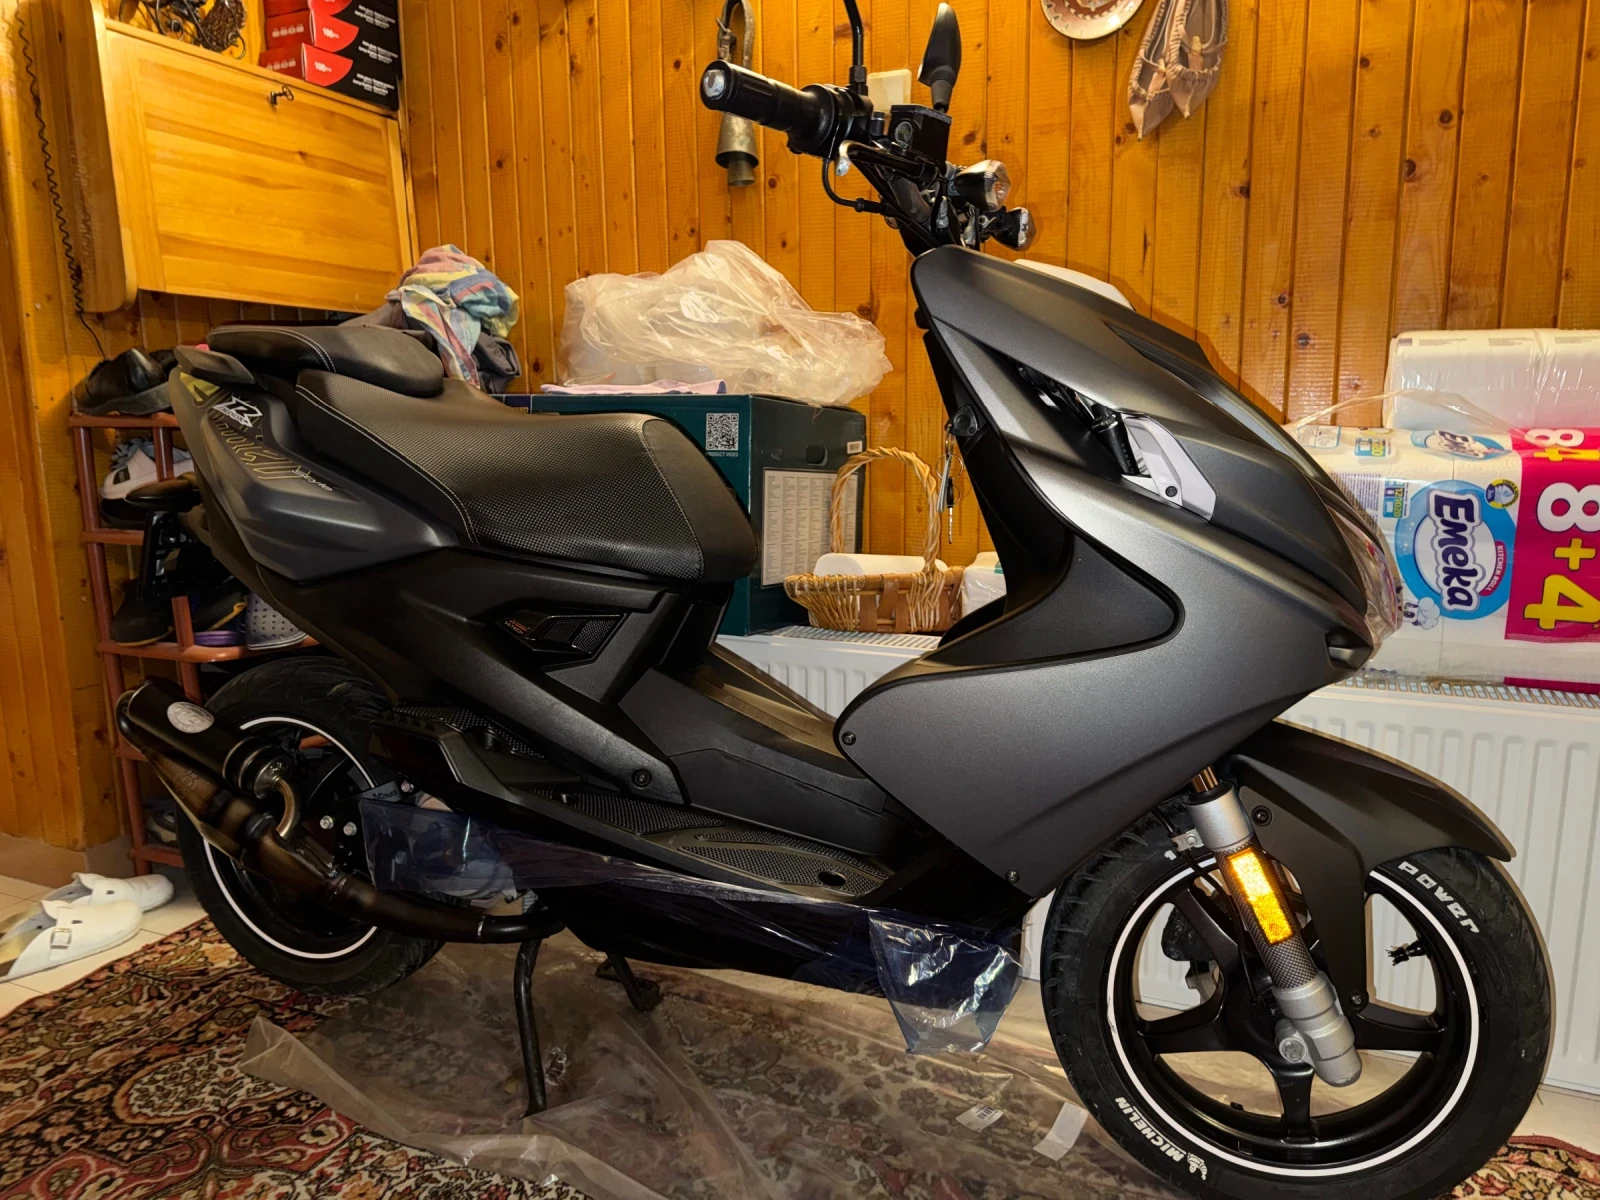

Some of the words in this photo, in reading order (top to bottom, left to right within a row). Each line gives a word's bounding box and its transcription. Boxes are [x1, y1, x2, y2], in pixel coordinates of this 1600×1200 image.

[1495, 545, 1504, 576] KITCHEN
[1486, 575, 1500, 592] ROLL
[1115, 1096, 1186, 1162] MICHELIN
